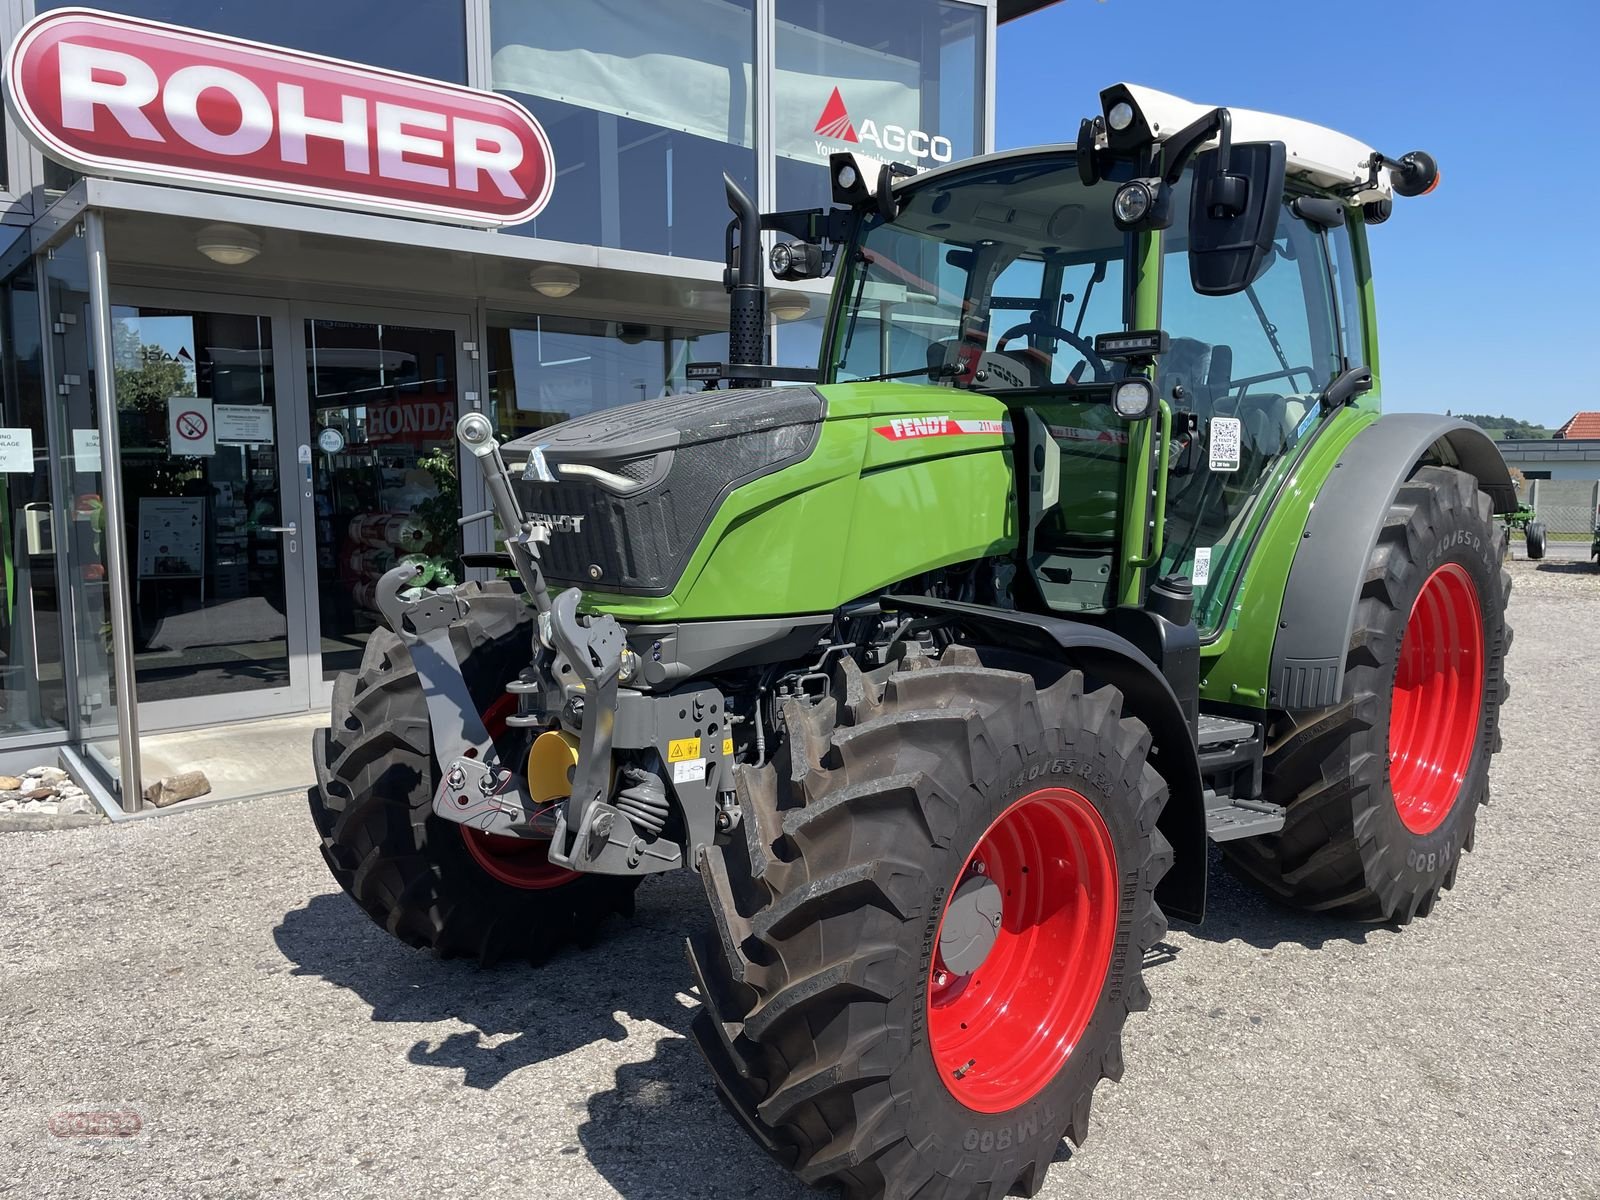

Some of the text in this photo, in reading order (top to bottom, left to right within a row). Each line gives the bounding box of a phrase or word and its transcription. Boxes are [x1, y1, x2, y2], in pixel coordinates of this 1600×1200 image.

[58, 42, 528, 201] ROHER
[858, 119, 953, 163] AGCO
[368, 401, 456, 435] HONDA
[890, 416, 949, 438] FENDT
[978, 420, 991, 431] 211
[910, 885, 946, 1052] TRELLEBORG
[1108, 867, 1140, 1005] TRELLEBORG
